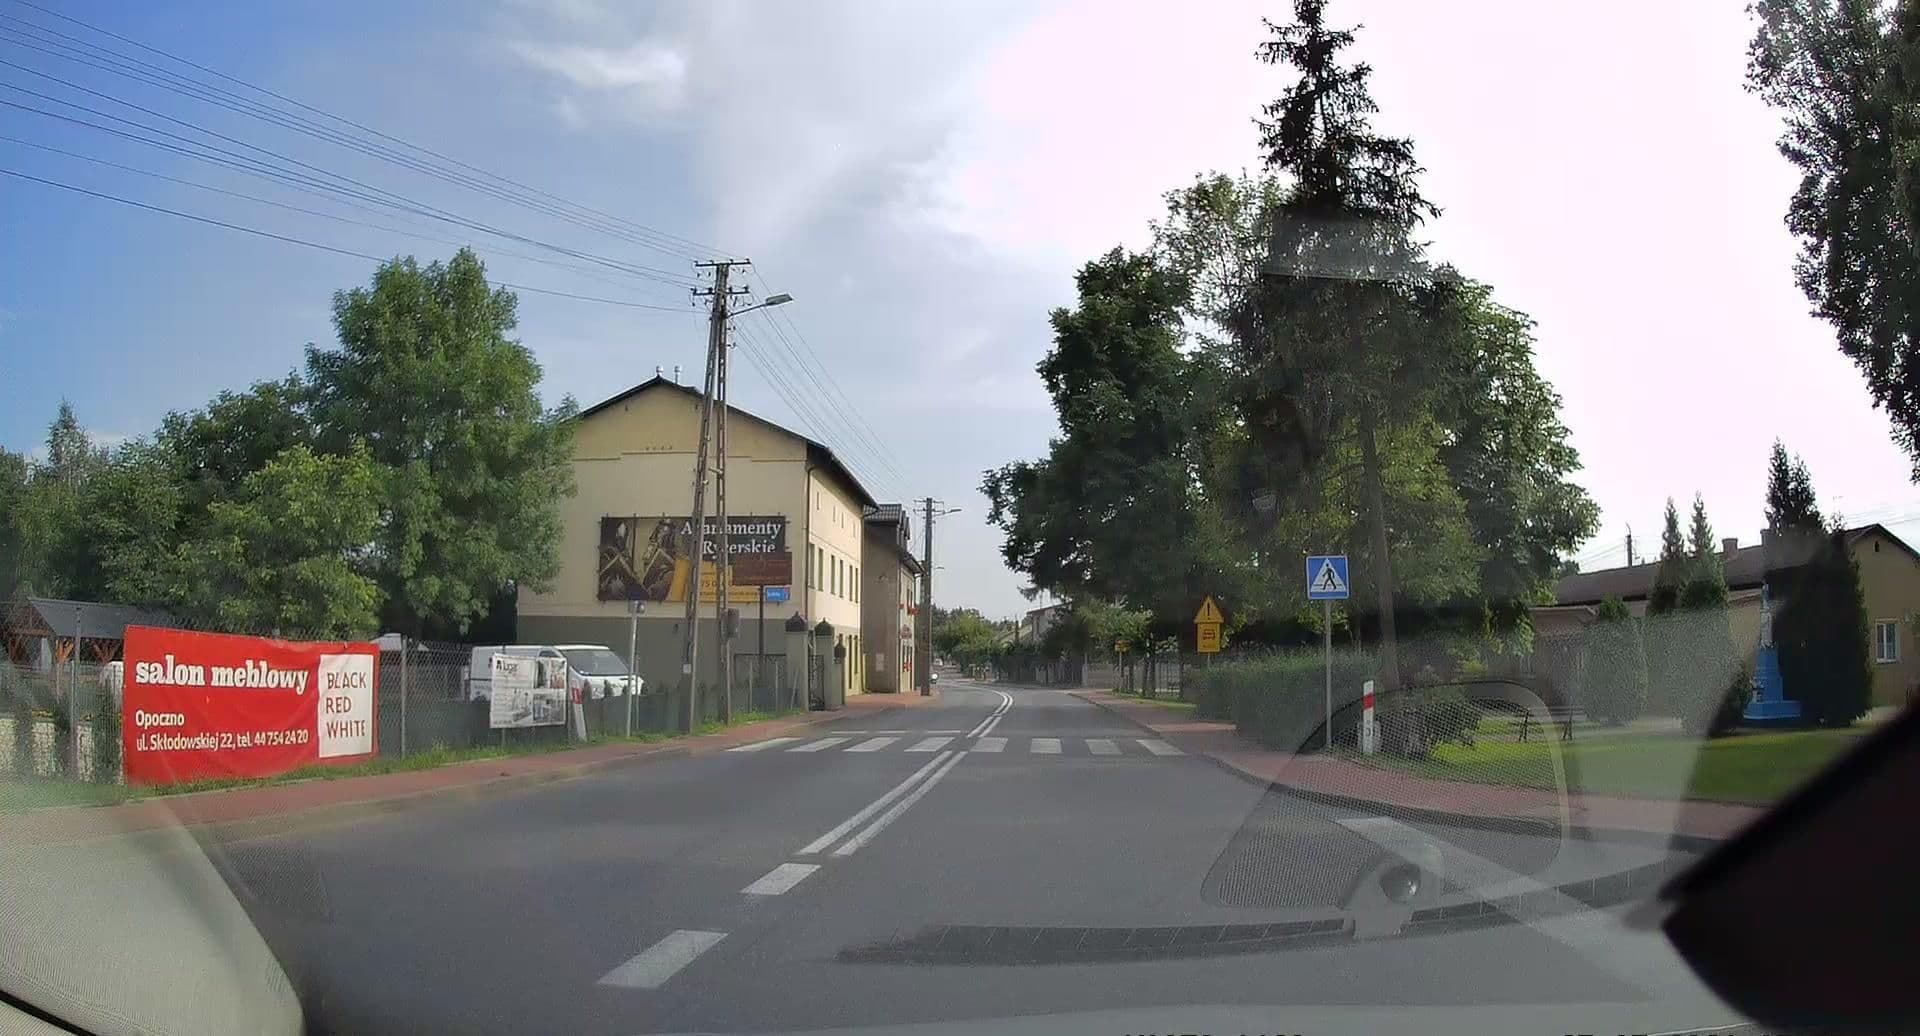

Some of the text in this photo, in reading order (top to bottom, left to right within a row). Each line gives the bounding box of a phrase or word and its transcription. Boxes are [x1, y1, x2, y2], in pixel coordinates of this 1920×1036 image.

[136, 655, 308, 695] salon meblowy
[327, 672, 367, 689] BLACK
[326, 697, 352, 714] RED
[136, 710, 184, 729] Opoczno
[327, 720, 366, 738] WHITE
[137, 733, 149, 751] ul.
[150, 732, 218, 752] Skłodowskiej
[220, 733, 236, 750] 22,
[237, 731, 252, 747] tel.
[297, 729, 309, 743] 20
